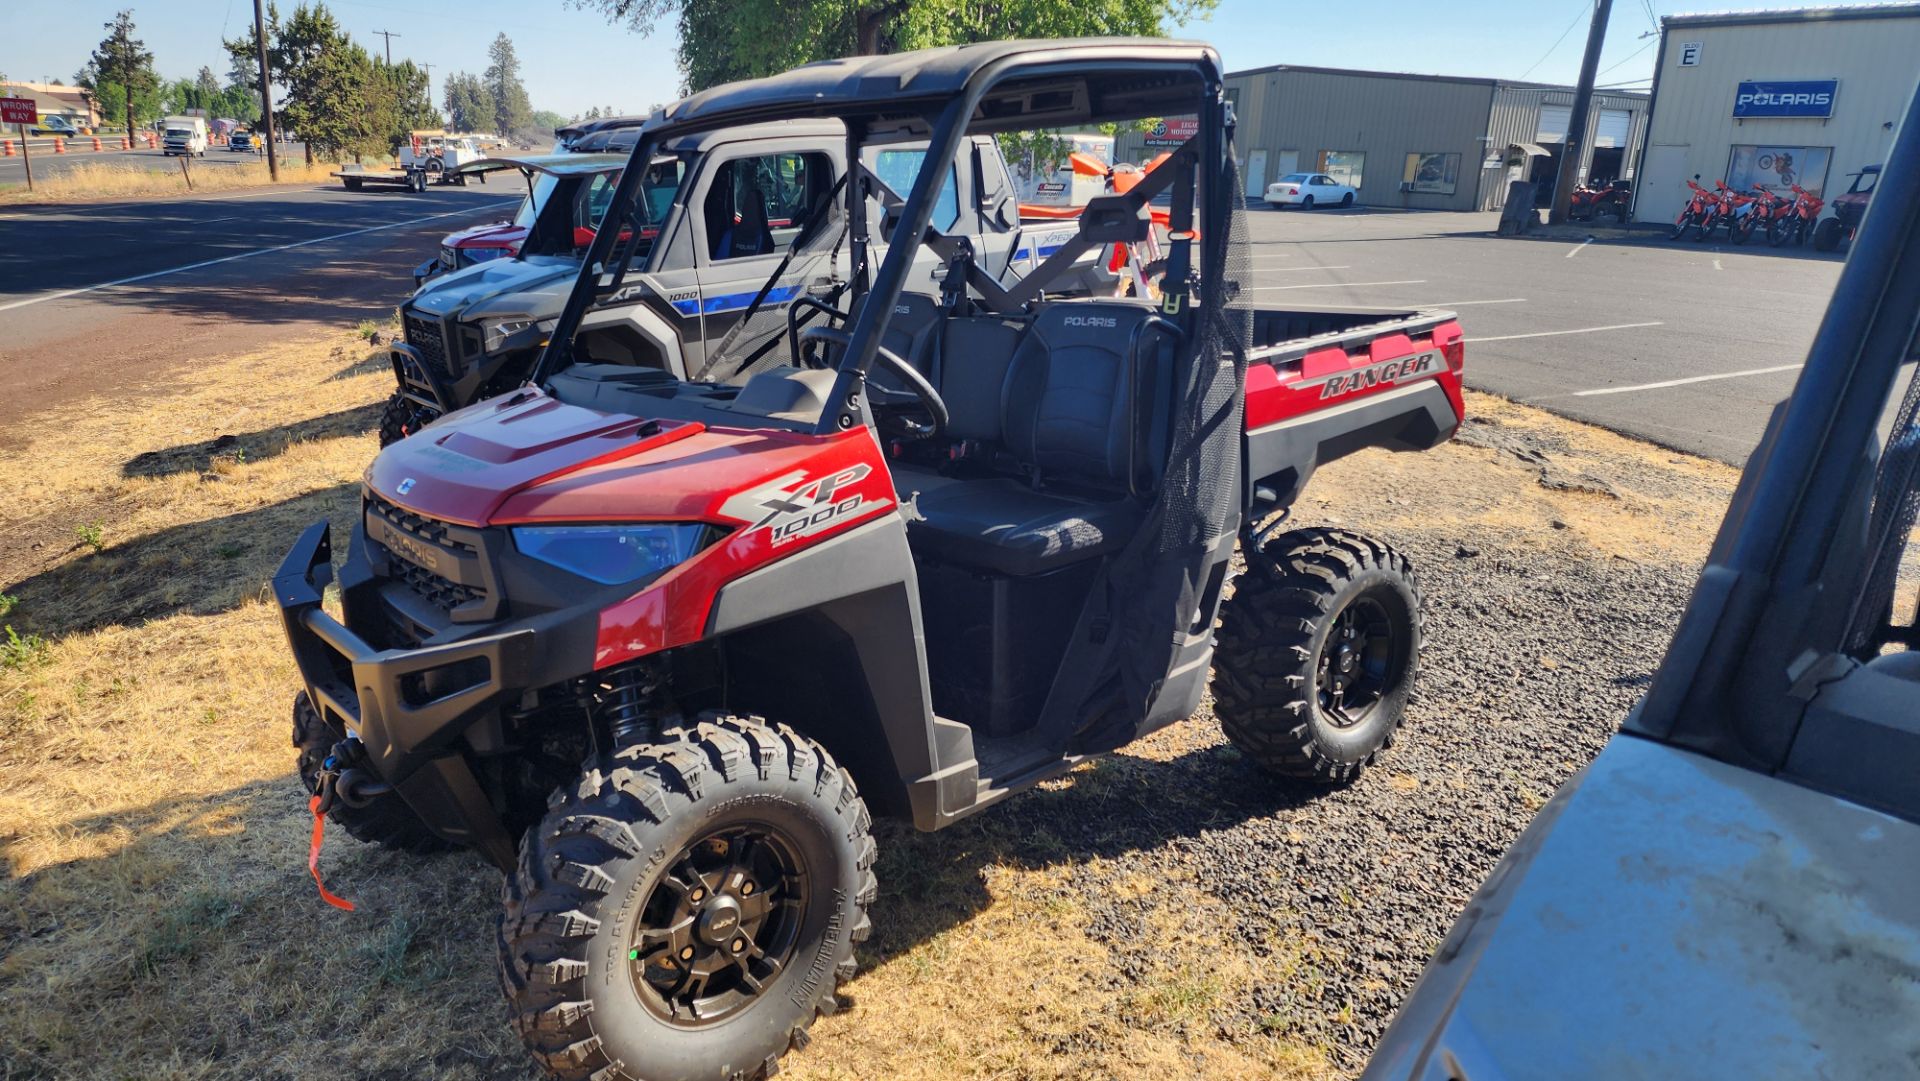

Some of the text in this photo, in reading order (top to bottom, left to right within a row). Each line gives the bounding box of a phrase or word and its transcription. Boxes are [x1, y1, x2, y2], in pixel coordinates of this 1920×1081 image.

[1682, 49, 1696, 65] E
[1, 101, 35, 111] WRONG
[1738, 93, 1830, 106] POLARIS
[9, 111, 29, 120] WAY
[607, 286, 642, 301] XP
[669, 291, 698, 301] 1000
[1064, 317, 1117, 328] POLARIS
[1320, 353, 1434, 400] RANGER
[740, 462, 873, 538] XP
[771, 494, 863, 542] 1000
[383, 525, 438, 569] POLARIS
